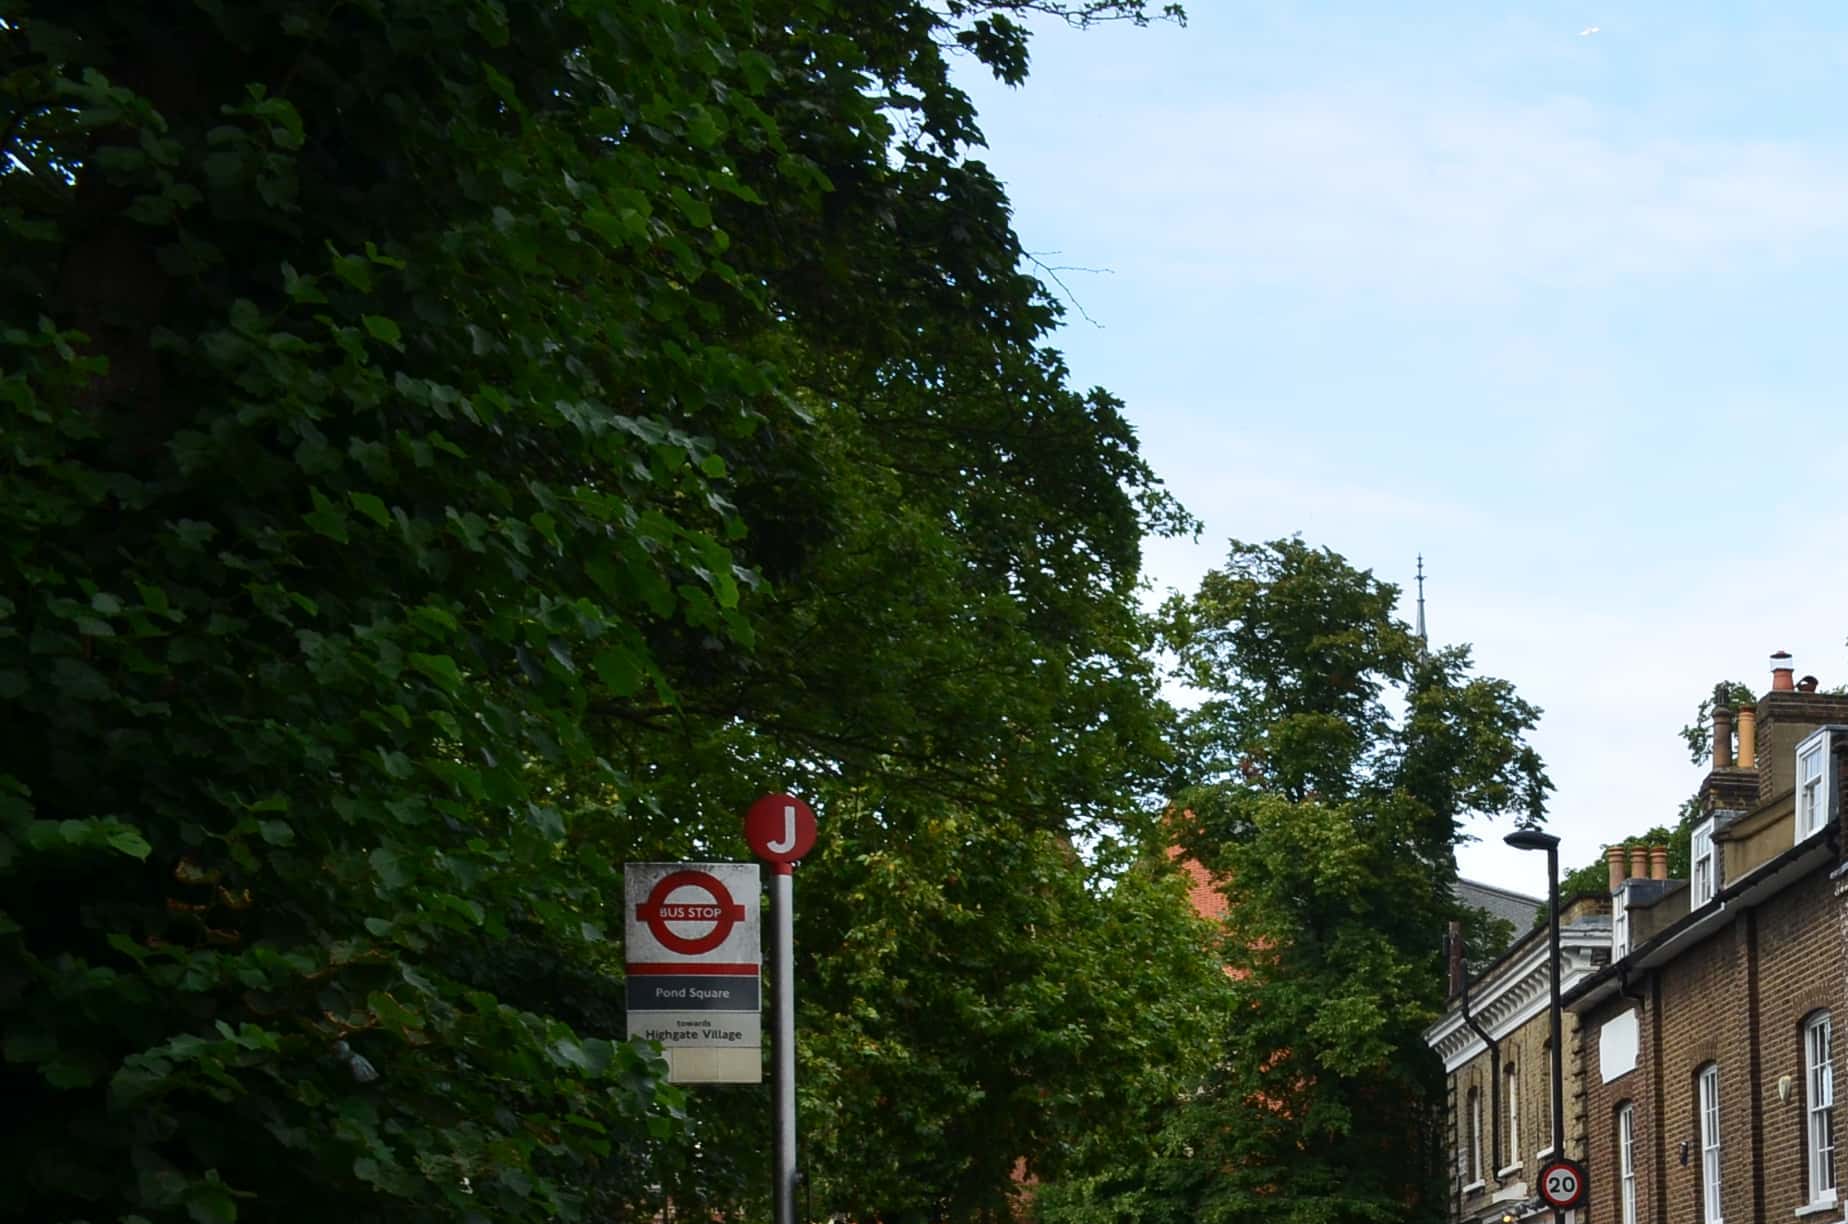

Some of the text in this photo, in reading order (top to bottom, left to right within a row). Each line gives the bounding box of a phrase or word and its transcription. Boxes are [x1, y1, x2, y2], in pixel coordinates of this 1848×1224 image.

[767, 806, 796, 854] J
[659, 906, 722, 919] BUS STOP
[655, 987, 731, 1000] Pond Square
[676, 1019, 712, 1028] towards
[645, 1029, 743, 1041] Highgate Village
[1548, 1176, 1576, 1193] 20
